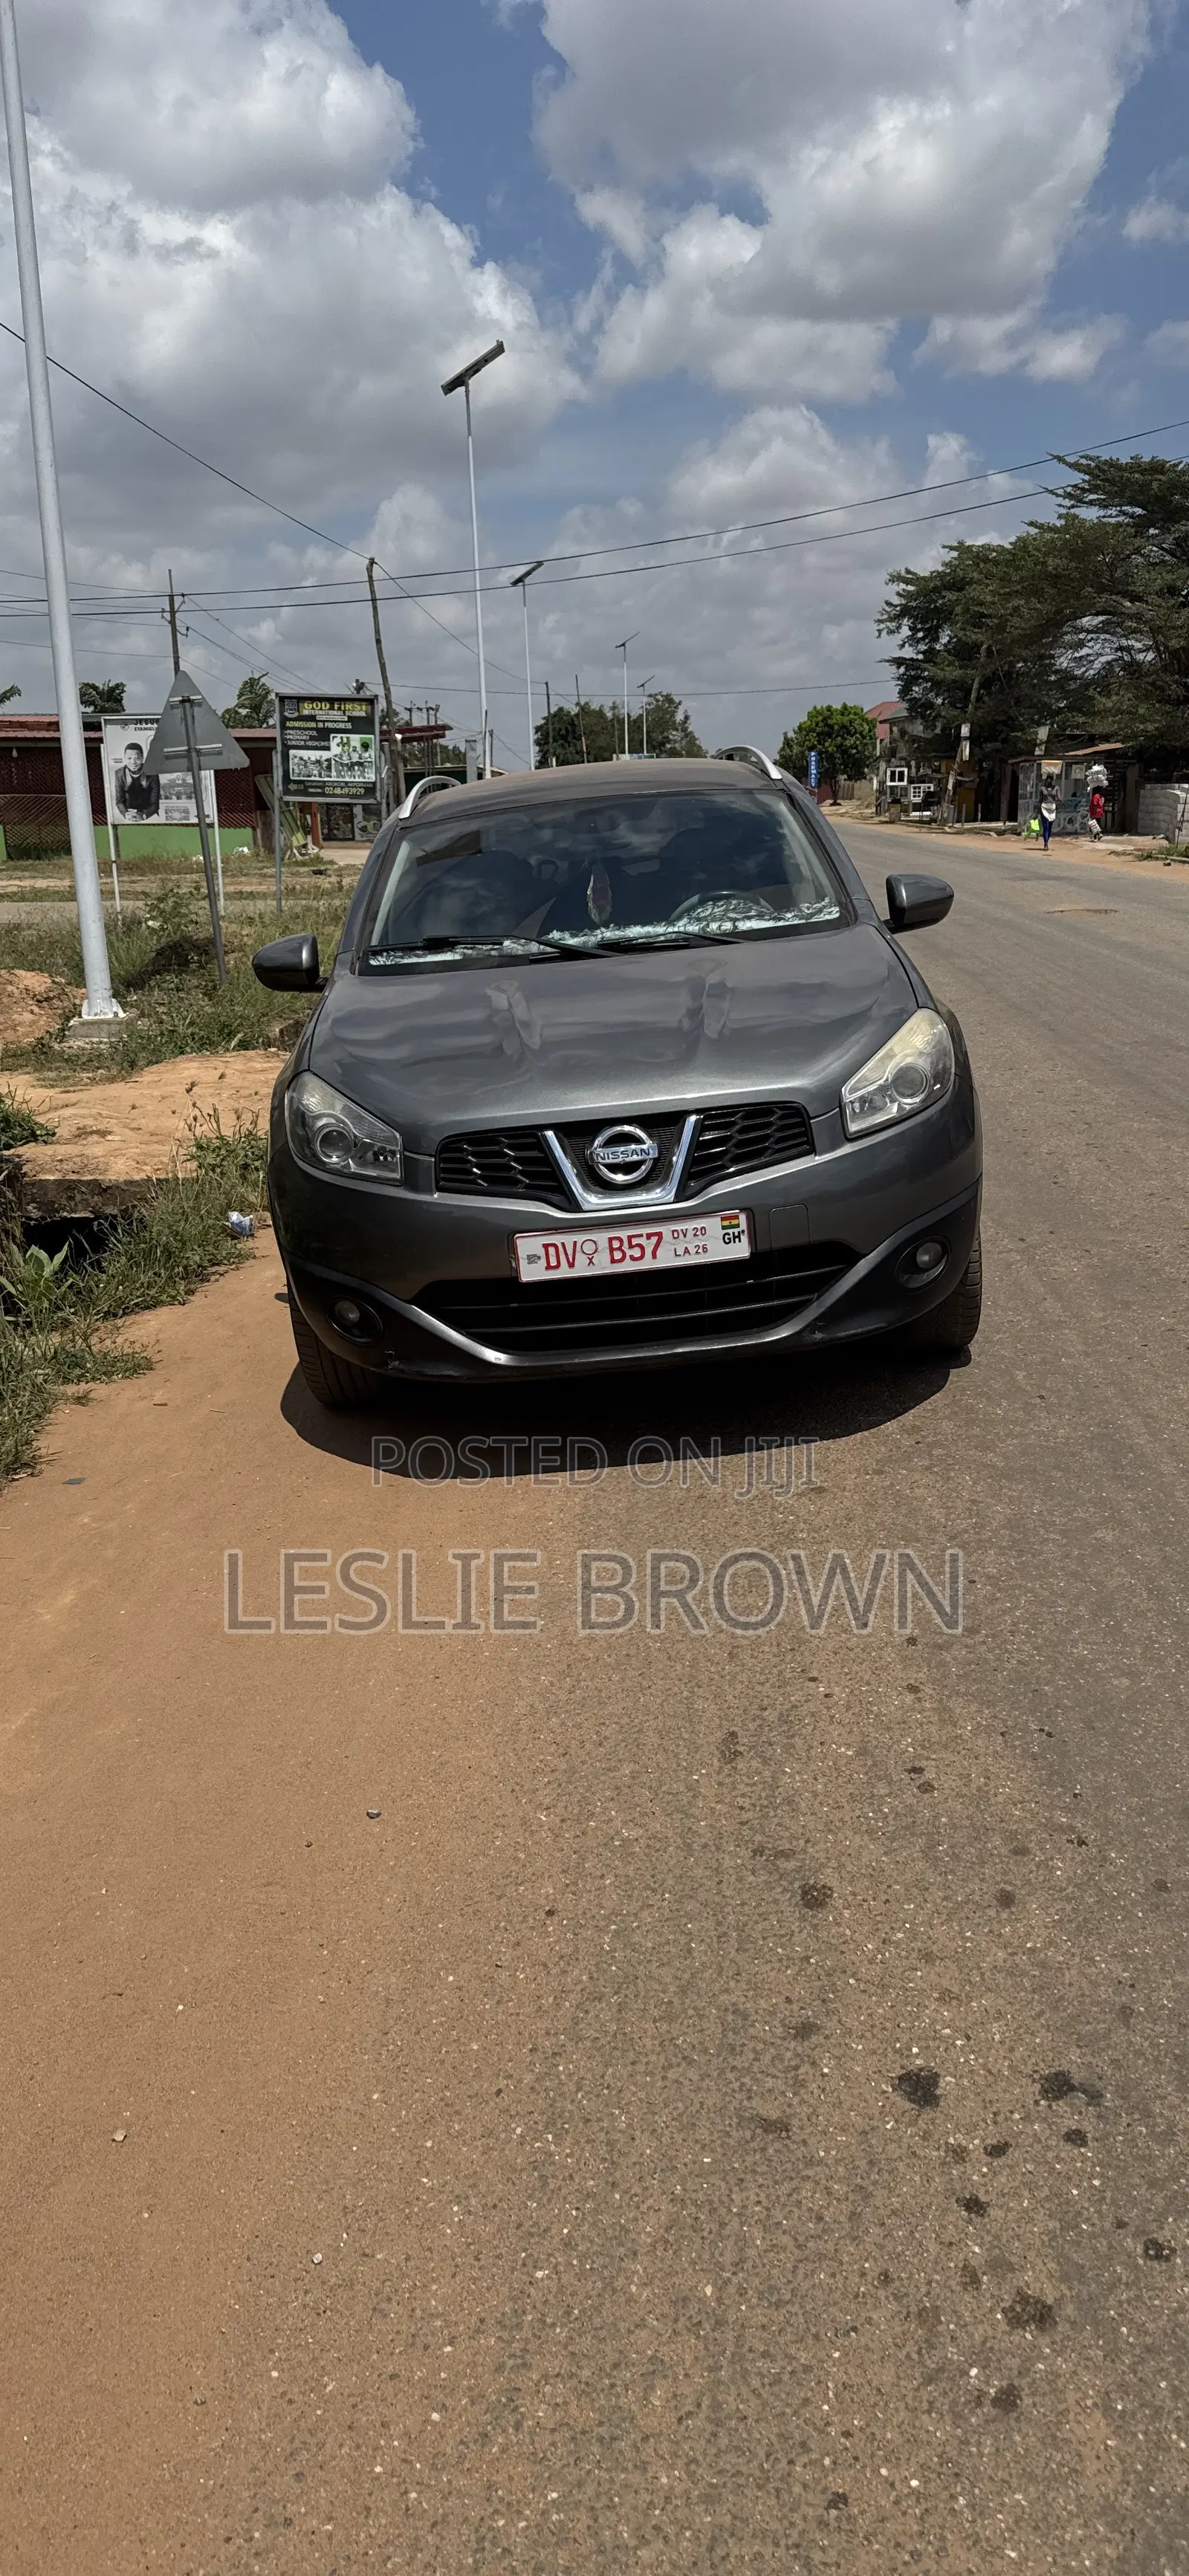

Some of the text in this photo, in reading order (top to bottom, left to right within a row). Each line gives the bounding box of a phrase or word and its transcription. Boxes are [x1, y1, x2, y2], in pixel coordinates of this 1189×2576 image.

[304, 701, 366, 710] GOD FIRST
[325, 787, 365, 795] 0248493929
[595, 1148, 650, 1161] NISSAN
[671, 1225, 707, 1239] DV 20
[722, 1230, 742, 1245] GH
[542, 1240, 577, 1271] DV
[608, 1230, 664, 1265] B57
[674, 1243, 708, 1257] LA 26
